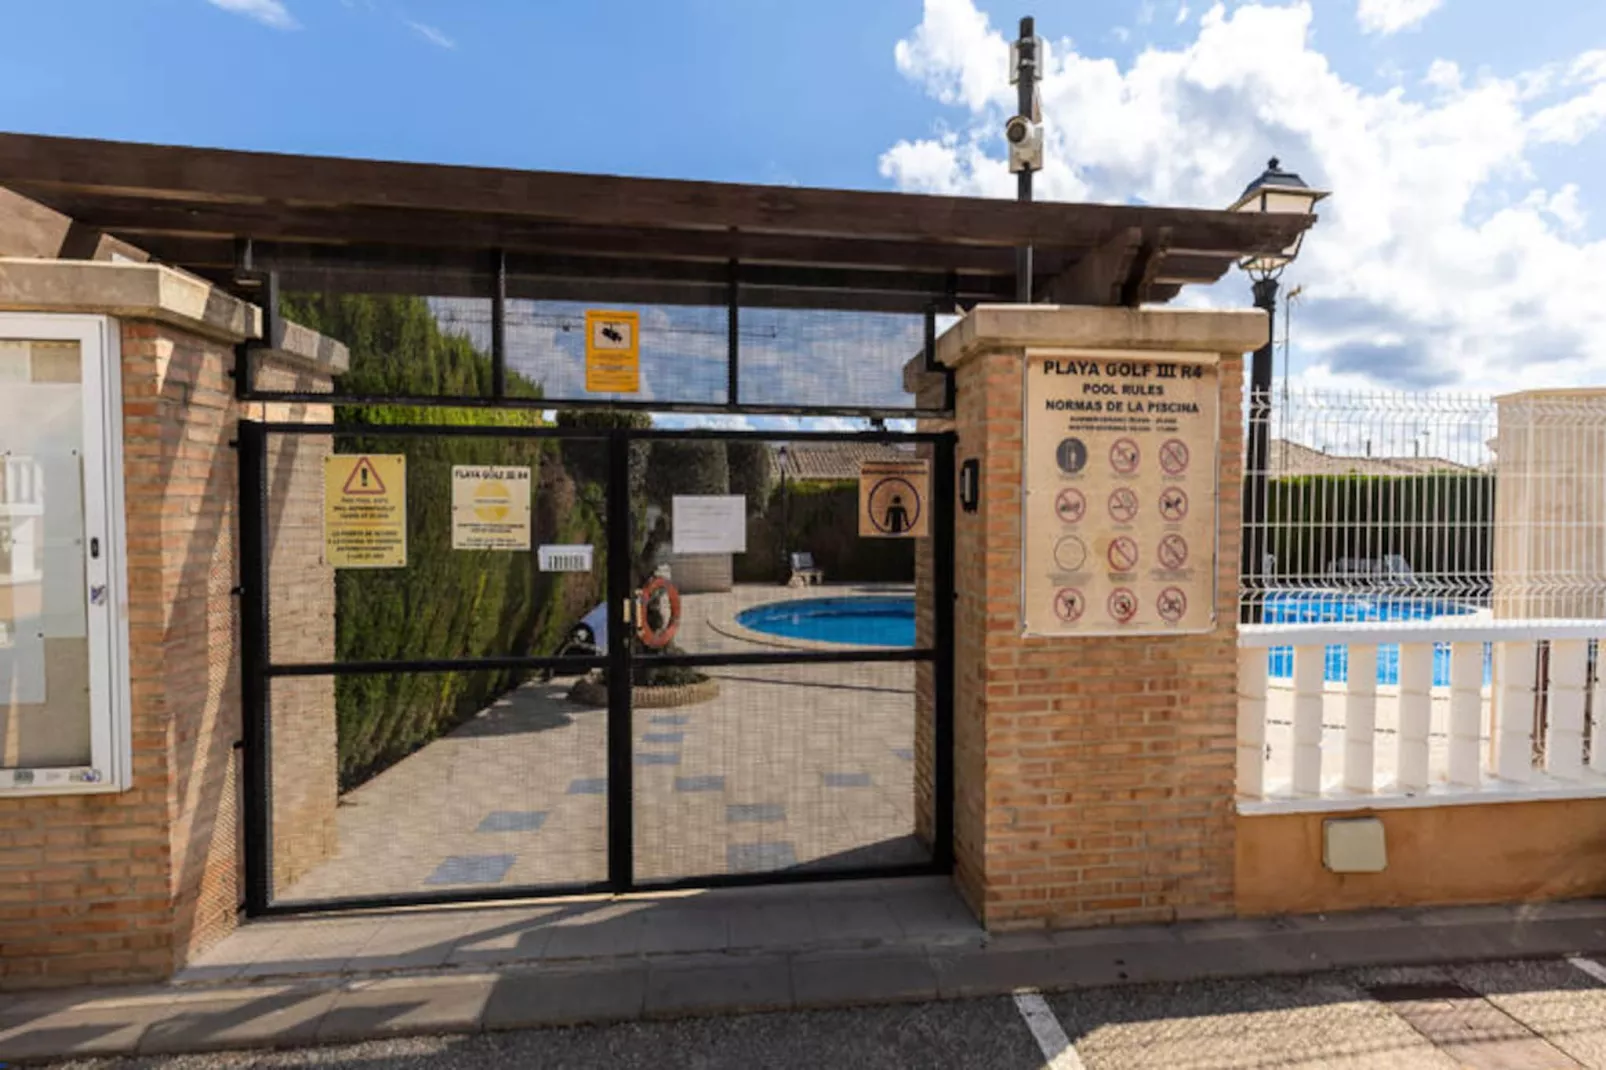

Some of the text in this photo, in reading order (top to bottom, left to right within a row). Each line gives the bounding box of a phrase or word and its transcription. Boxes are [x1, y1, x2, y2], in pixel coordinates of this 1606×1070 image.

[1043, 360, 1204, 379] PLAYA GOLF III R4
[1082, 383, 1165, 396] POOL RULES
[1045, 399, 1200, 414] NORMAS DE LA PISCINA
